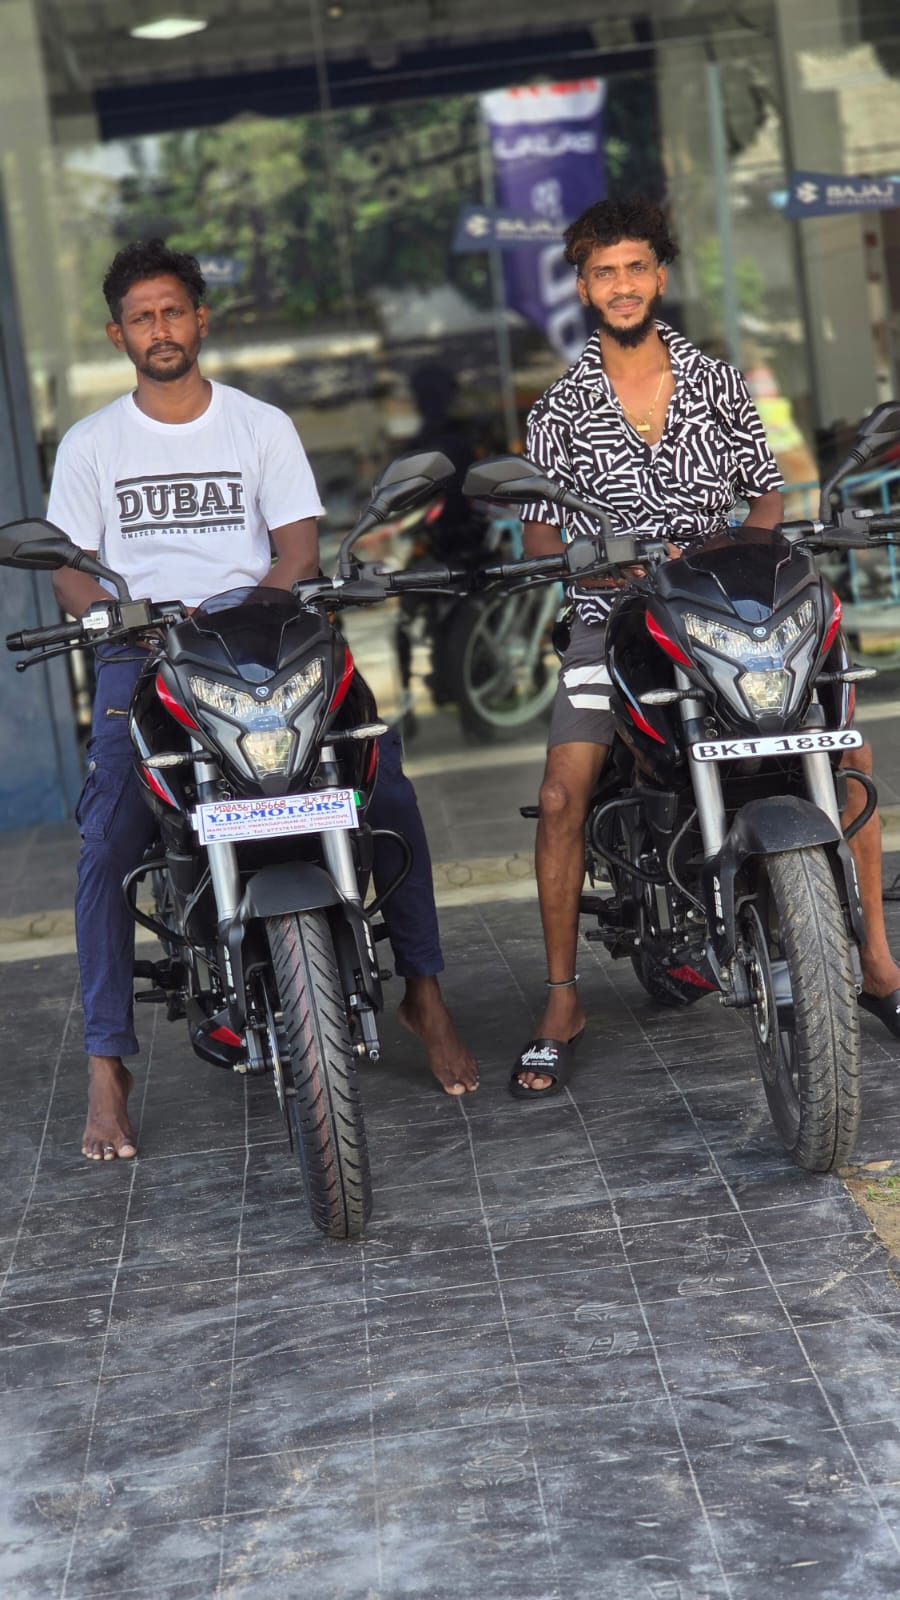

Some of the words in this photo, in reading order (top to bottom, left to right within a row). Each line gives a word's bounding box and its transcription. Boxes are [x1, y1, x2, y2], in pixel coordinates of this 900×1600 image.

[826, 184, 894, 198] BAJAJ
[116, 481, 246, 523] DUBAI
[121, 529, 156, 540] UNITED
[193, 525, 246, 535] EMIRATES
[775, 733, 857, 752] 1886
